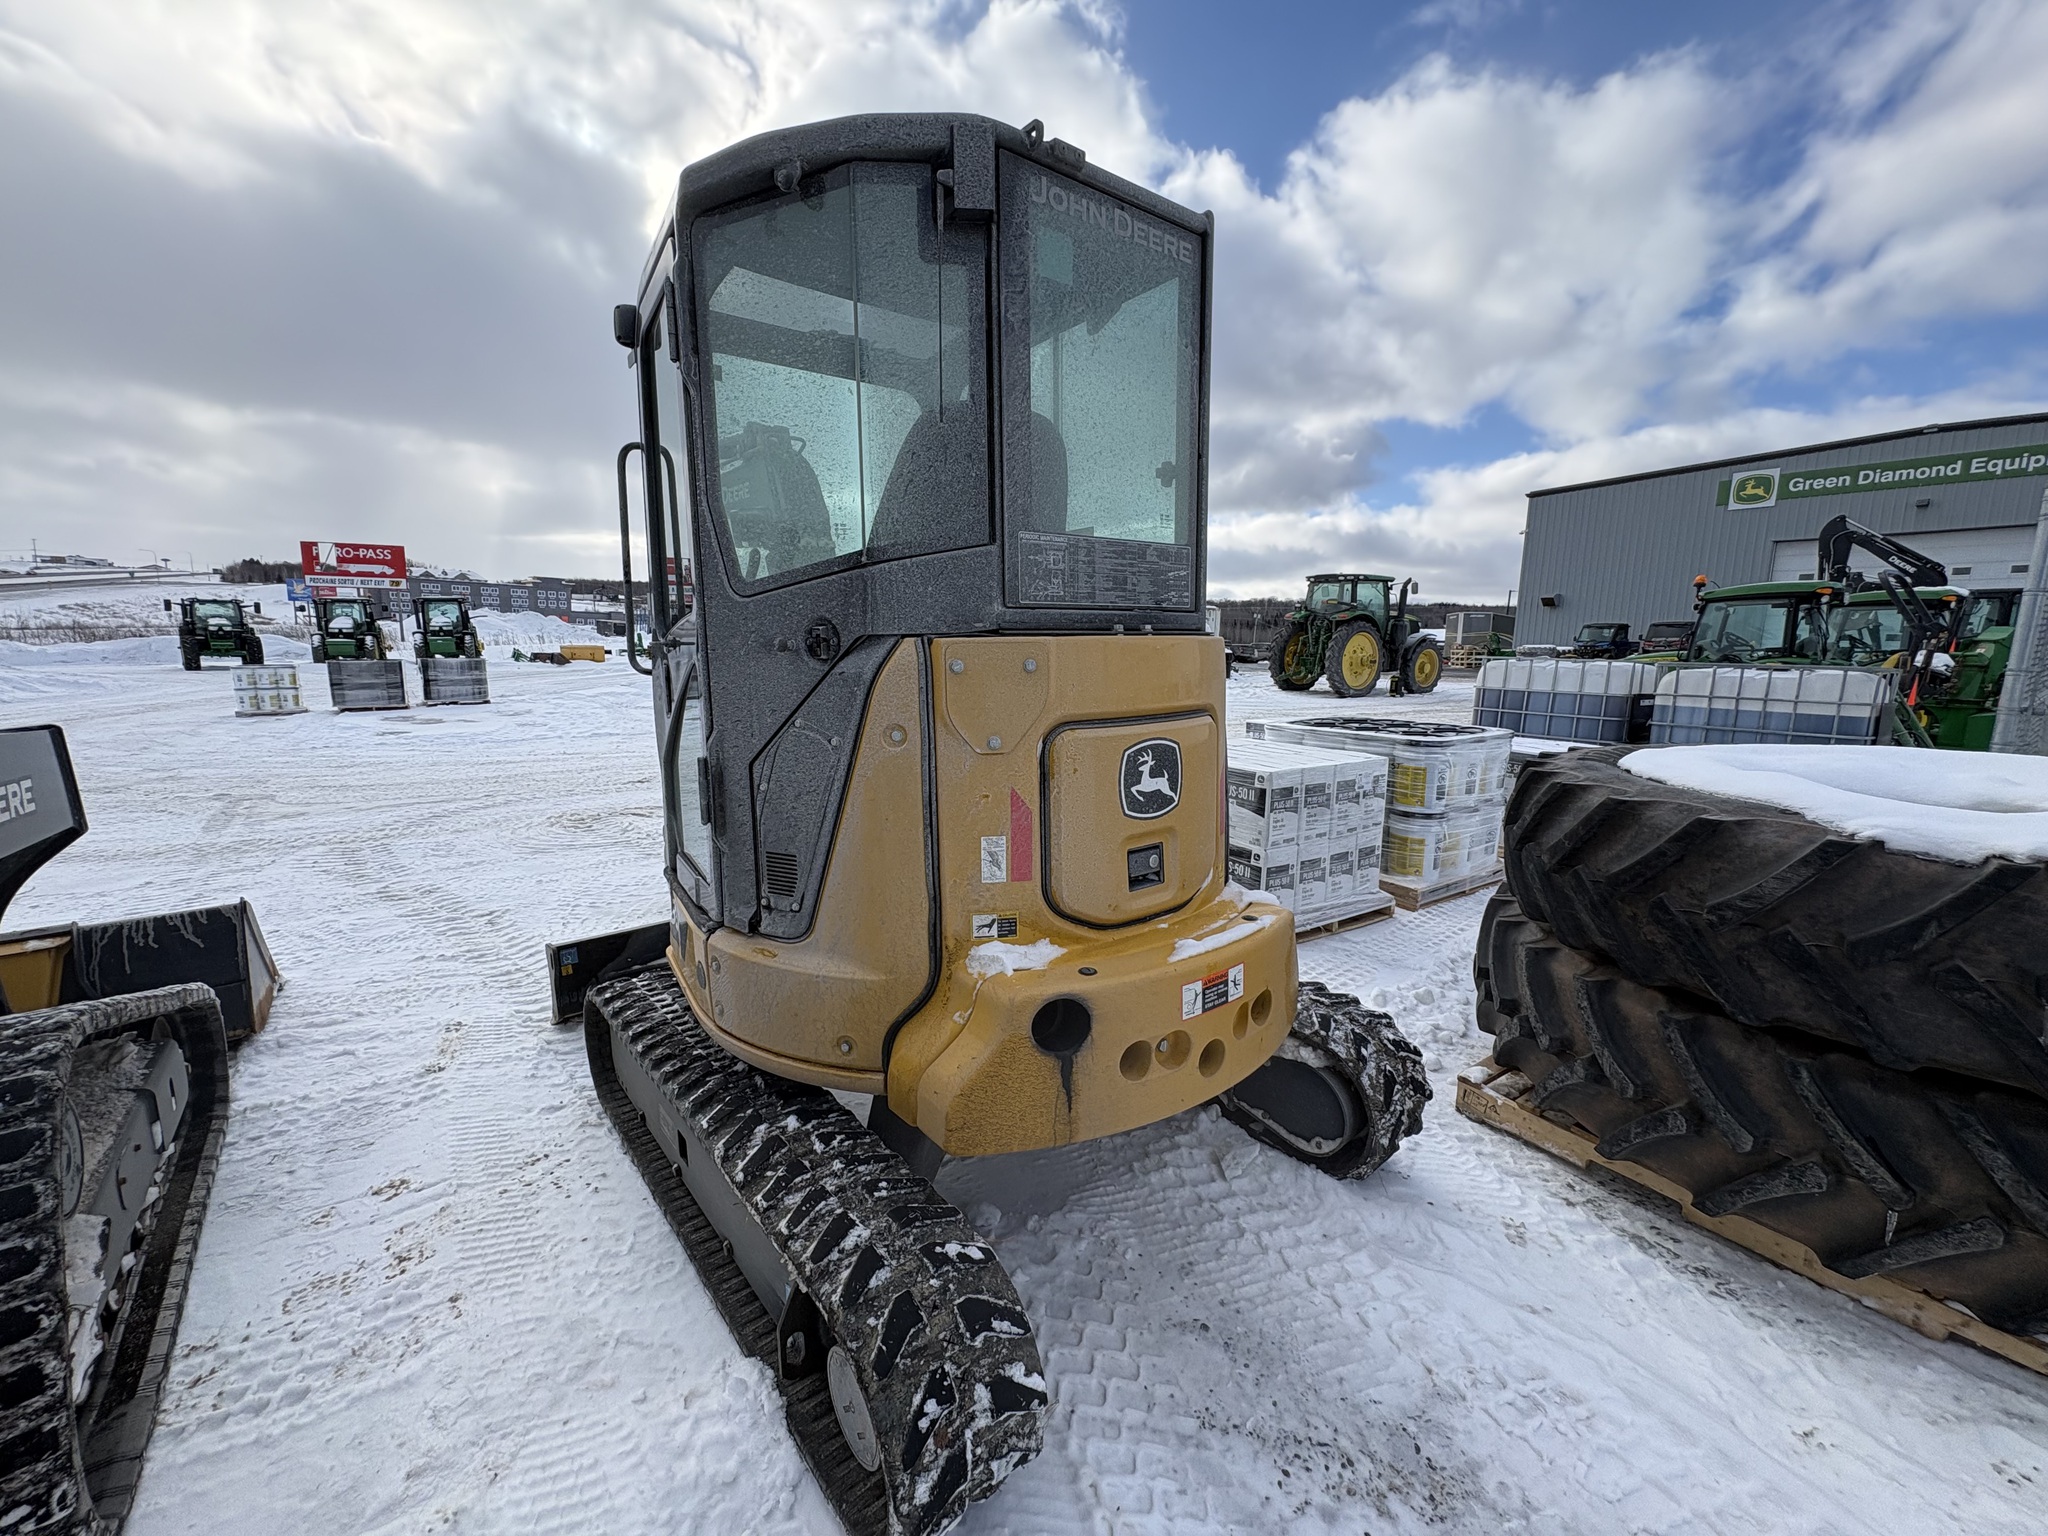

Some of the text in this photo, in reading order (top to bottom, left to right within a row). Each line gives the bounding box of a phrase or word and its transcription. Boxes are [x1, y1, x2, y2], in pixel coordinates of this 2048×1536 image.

[1031, 175, 1193, 264] JOHN DEERE
[1788, 452, 2048, 492] Green Diamond Equip
[1888, 555, 1918, 574] DEERE
[1207, 972, 1228, 983] WARNING
